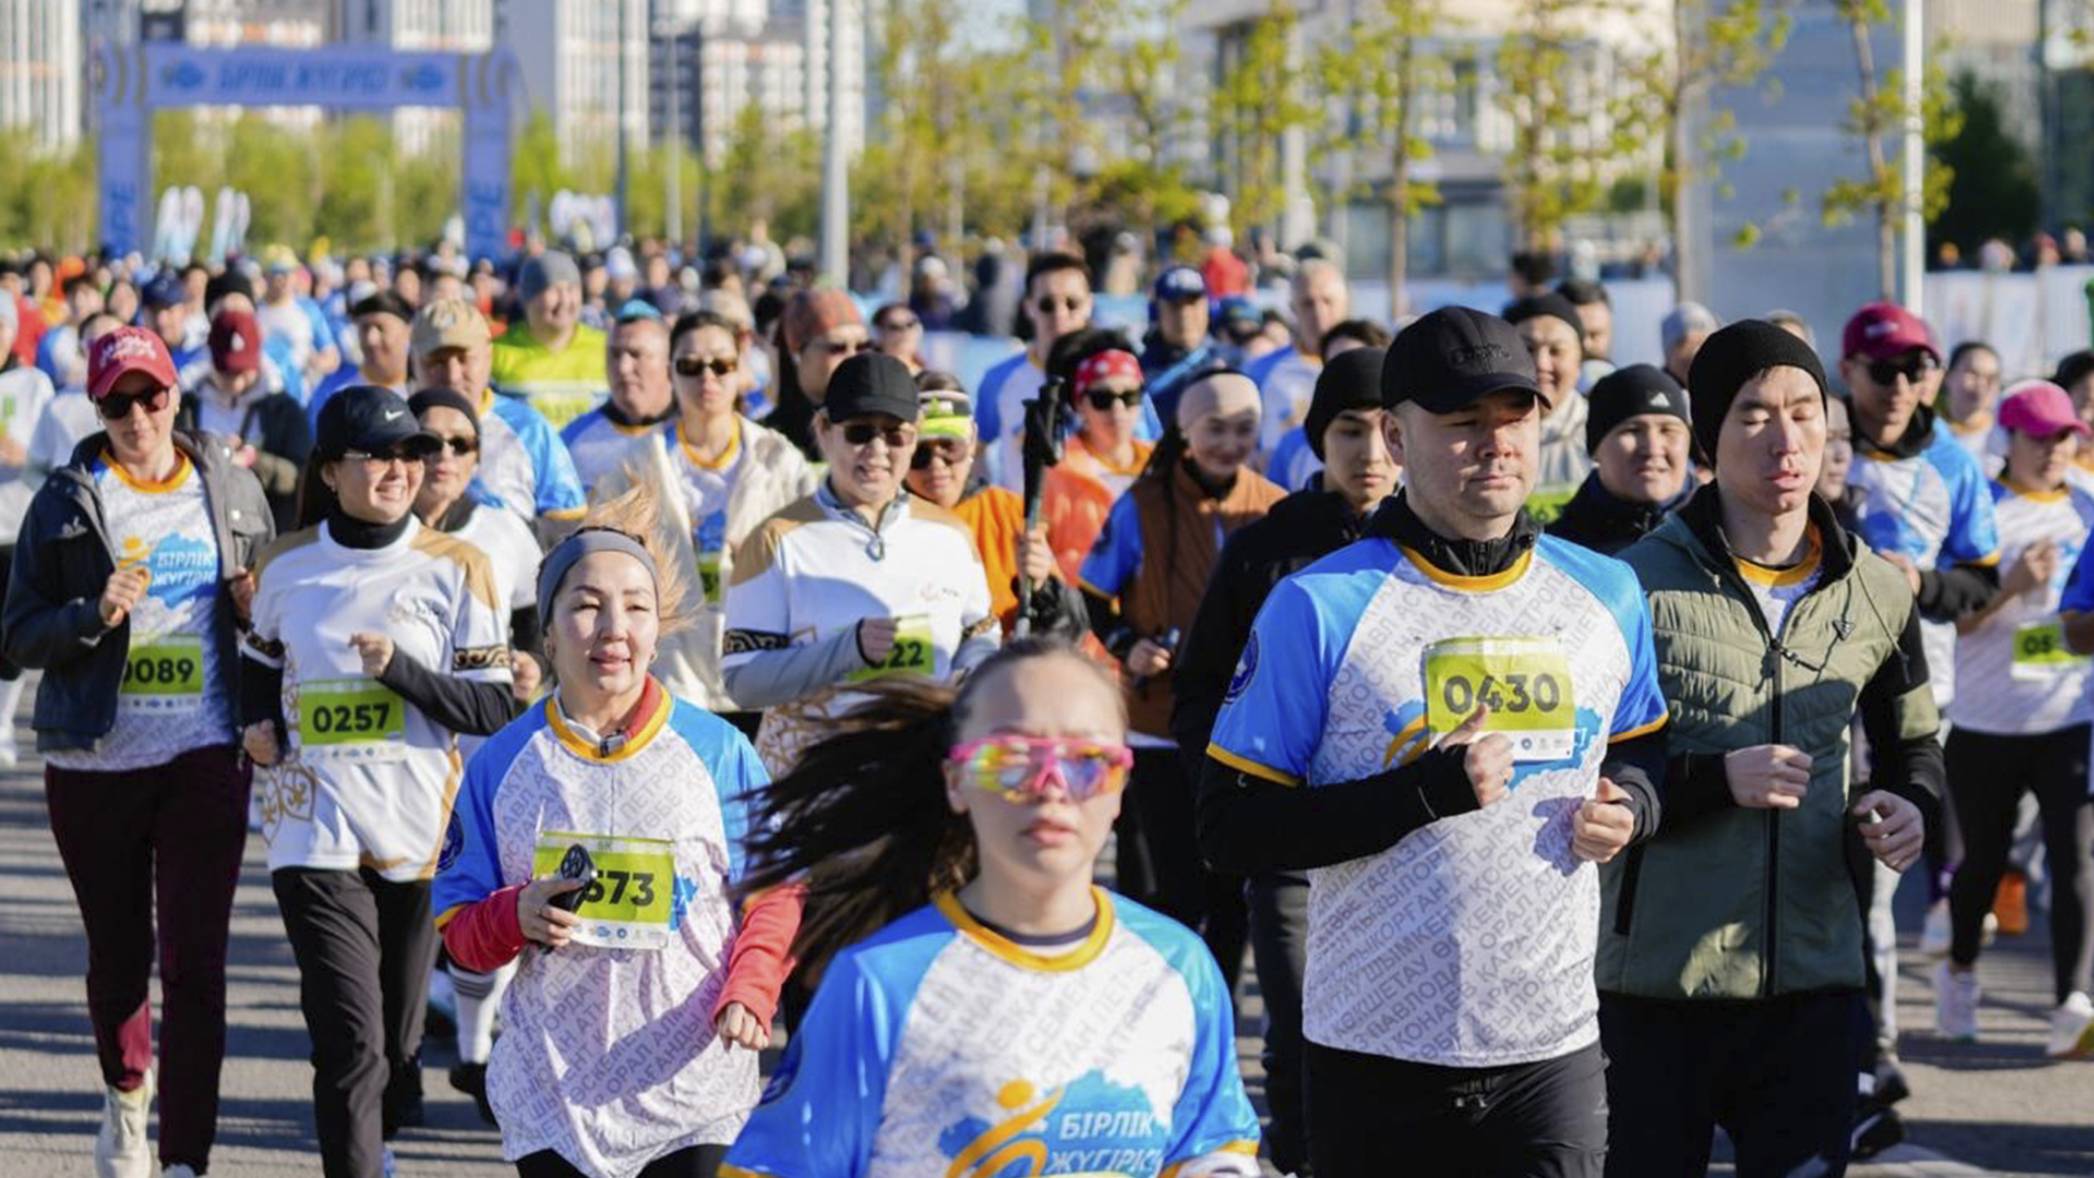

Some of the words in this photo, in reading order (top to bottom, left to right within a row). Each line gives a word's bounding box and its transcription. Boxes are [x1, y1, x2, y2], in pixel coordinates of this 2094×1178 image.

[887, 640, 925, 668] 22
[1443, 673, 1561, 715] 0430
[312, 704, 390, 733] 0257
[1475, 891, 1535, 954] ОРАЛ
[602, 1040, 653, 1097] ОРАЛ
[1059, 1109, 1155, 1140] БІРЛІК
